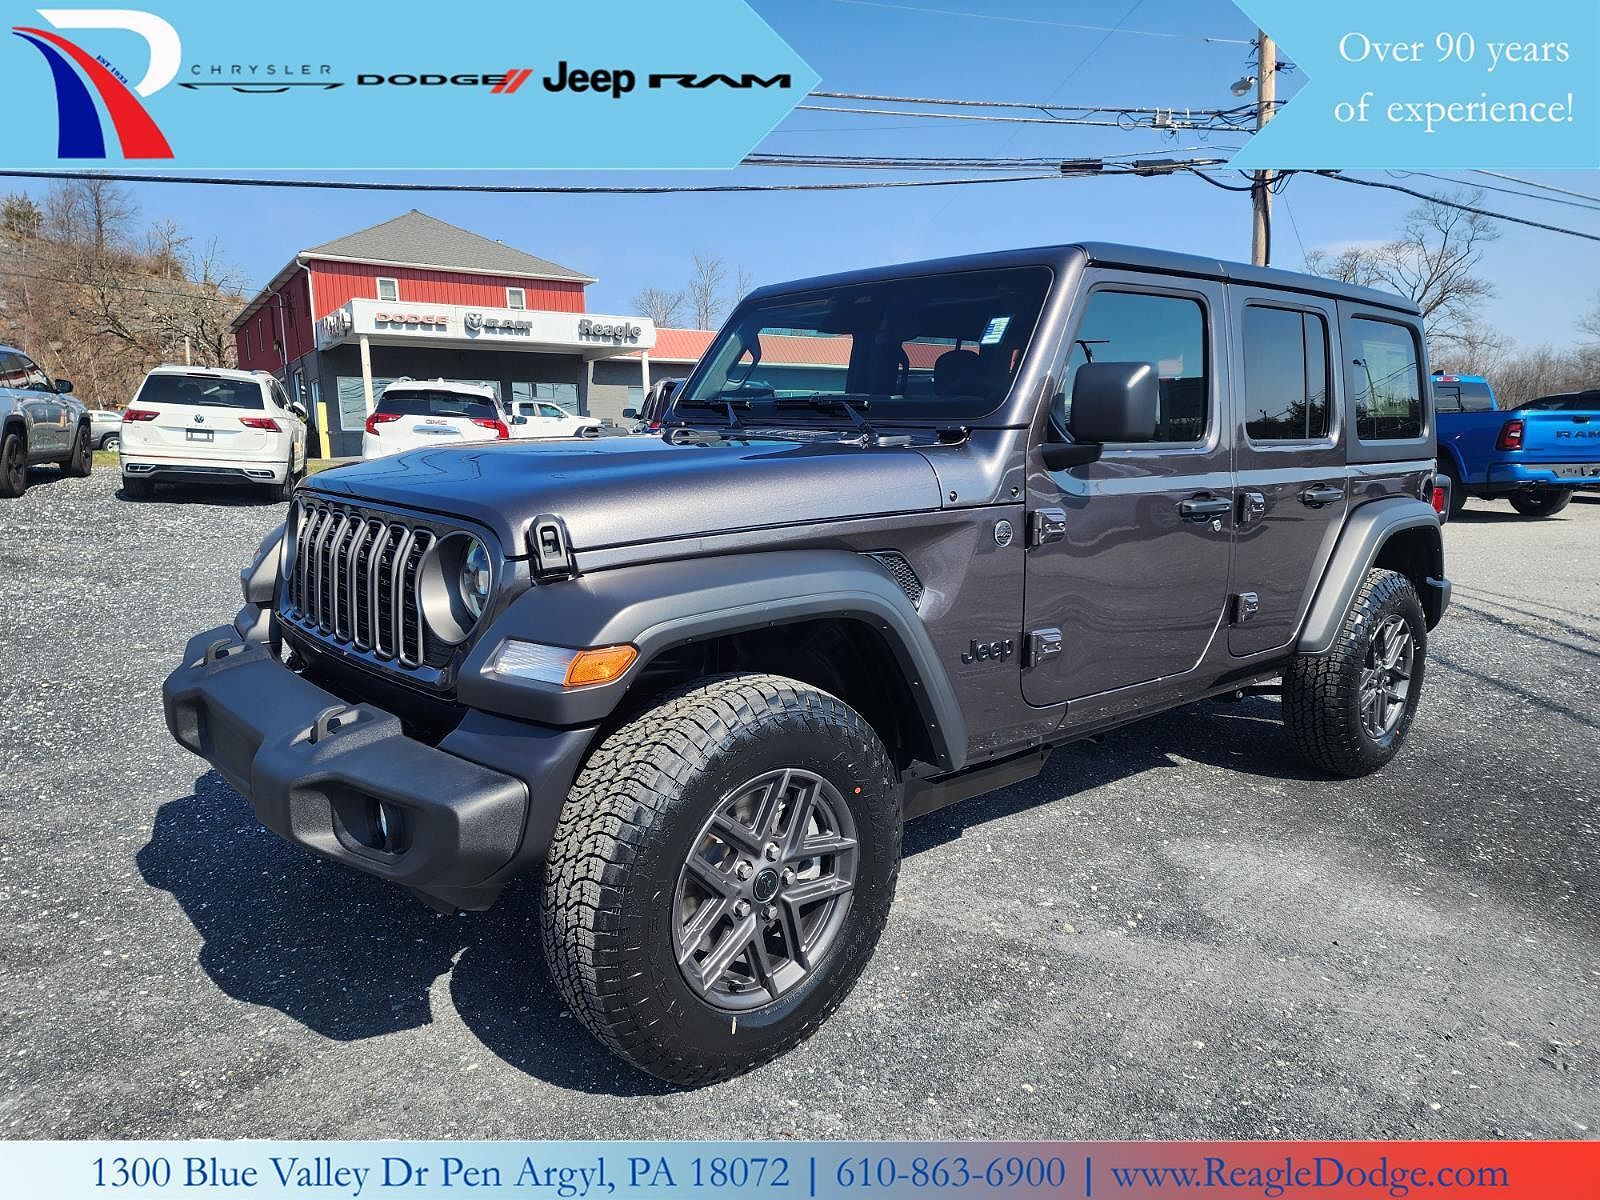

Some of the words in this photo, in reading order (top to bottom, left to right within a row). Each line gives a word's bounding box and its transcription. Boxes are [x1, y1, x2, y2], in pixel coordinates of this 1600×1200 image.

[376, 312, 450, 325] DODGE
[487, 318, 533, 328] RAM
[579, 319, 642, 340] Reagle
[961, 639, 1014, 665] Jeep
